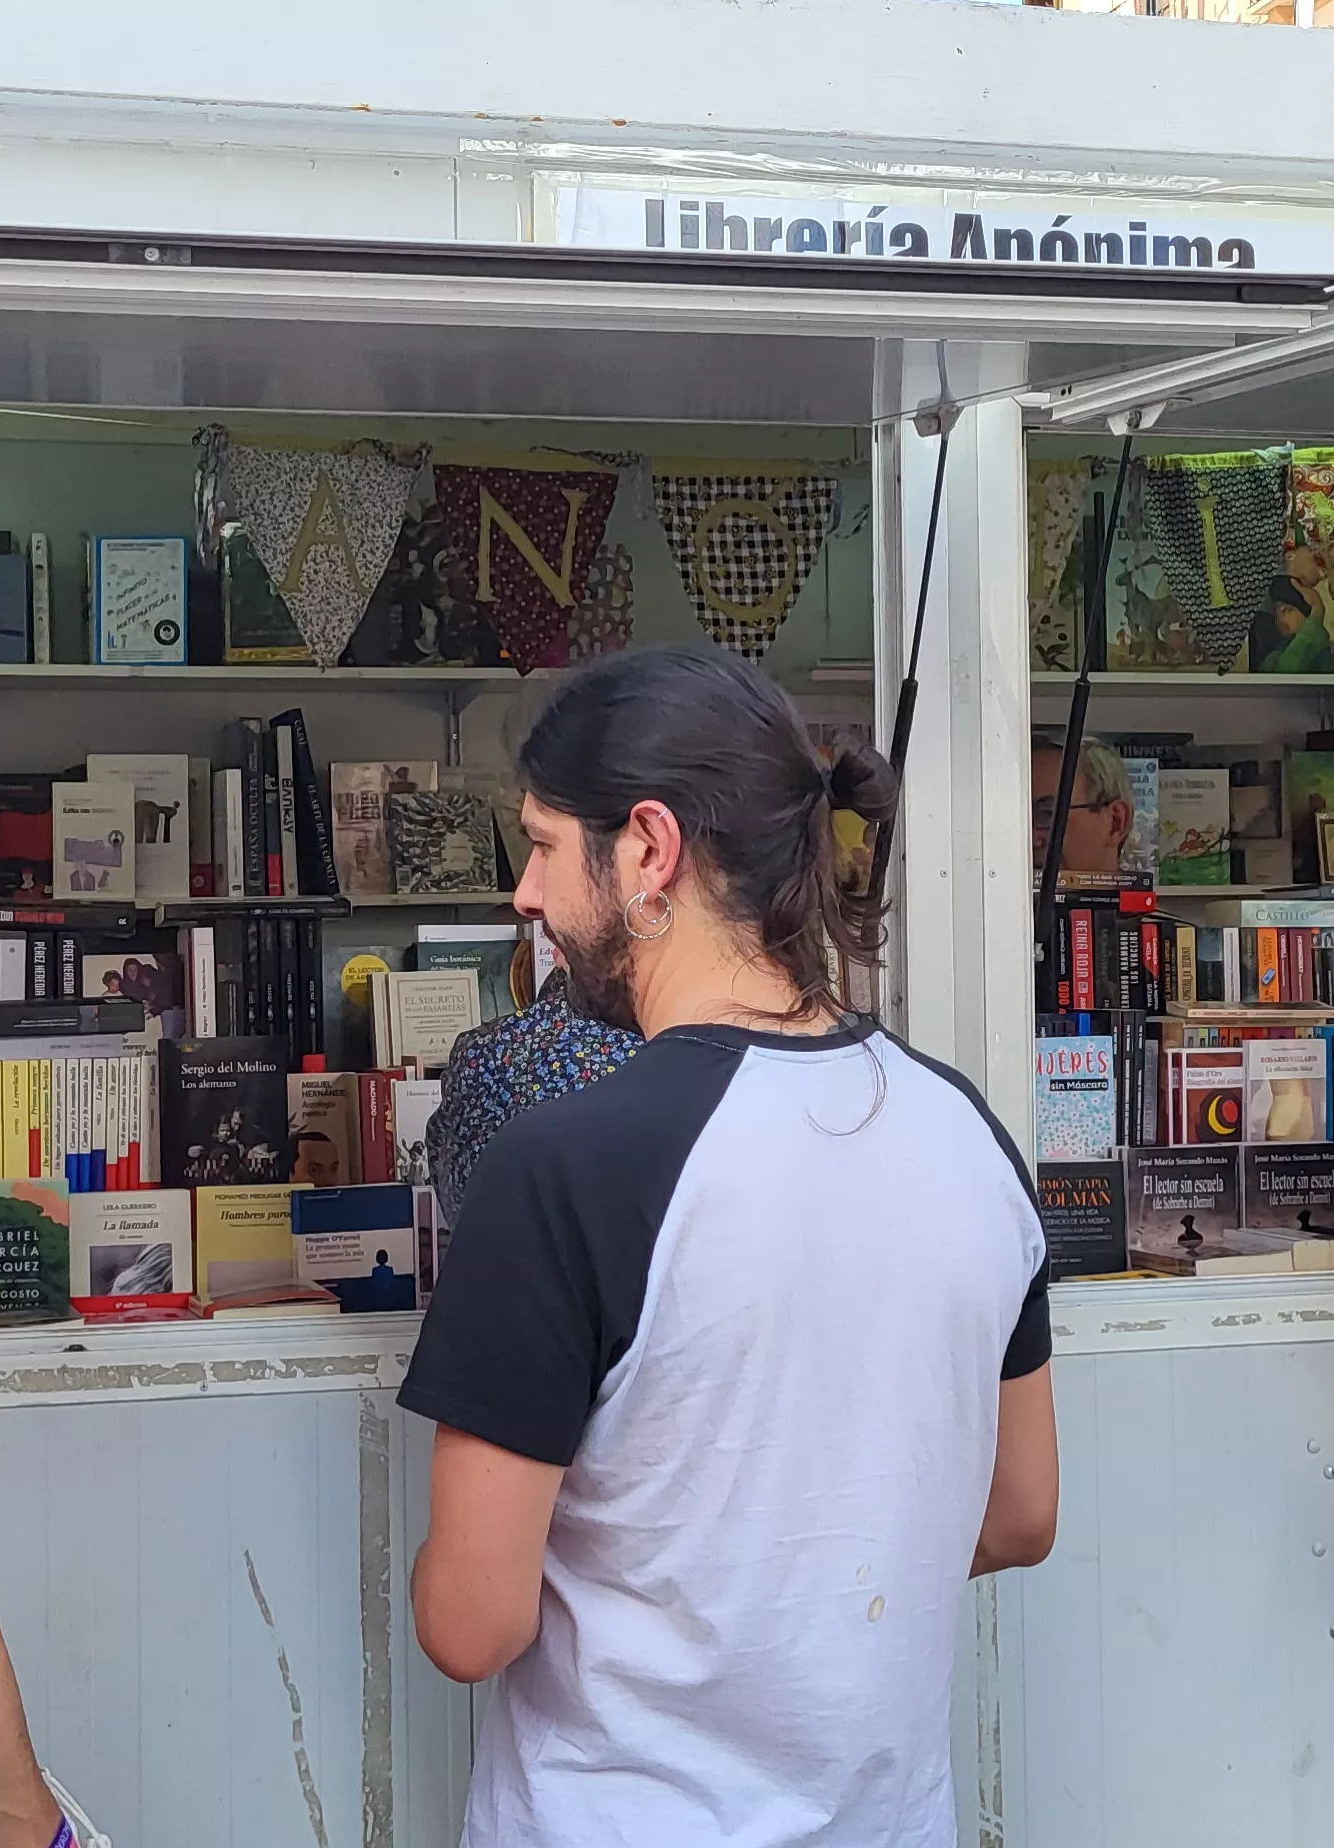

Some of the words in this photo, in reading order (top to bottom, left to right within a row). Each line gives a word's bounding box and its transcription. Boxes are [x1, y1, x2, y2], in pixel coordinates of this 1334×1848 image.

[281, 778, 294, 834] BANKSY
[249, 828, 259, 873] ESPAÑA
[1255, 909, 1310, 921] CASTILLO
[1075, 920, 1088, 950] REINA
[34, 941, 47, 963] PÉREZ
[63, 939, 76, 962] PÉREZ
[1130, 932, 1139, 966] VENCEJOS
[1077, 953, 1089, 978] ROJA
[34, 964, 45, 997] HEREDIA
[63, 963, 75, 994] HEREDIA
[1130, 970, 1139, 984] LOS
[404, 996, 417, 1005] EL
[419, 995, 465, 1004] SECRETO
[95, 1066, 103, 1090] familia
[180, 1062, 215, 1077] Sergio
[217, 1061, 233, 1073] del
[237, 1060, 276, 1073] Molino
[181, 1079, 196, 1089] Los
[197, 1078, 237, 1089] alemanes
[301, 1080, 332, 1089] MIGUEL
[1051, 1081, 1065, 1090] sin
[1067, 1080, 1108, 1090] Máscara
[1137, 1157, 1153, 1167] José
[1154, 1157, 1175, 1166] María
[1254, 1154, 1269, 1163] José
[1271, 1154, 1291, 1162] María
[1075, 1177, 1109, 1189] TAPIA
[1143, 1175, 1154, 1195] El
[1154, 1174, 1178, 1194] lector
[1180, 1174, 1193, 1192] sin
[1194, 1173, 1224, 1192] escuela
[1259, 1171, 1269, 1190] El
[1271, 1171, 1295, 1189] lector
[1297, 1169, 1309, 1189] sin
[103, 1220, 116, 1230] La
[119, 1219, 159, 1230] llamada
[220, 1210, 265, 1221] Hombres
